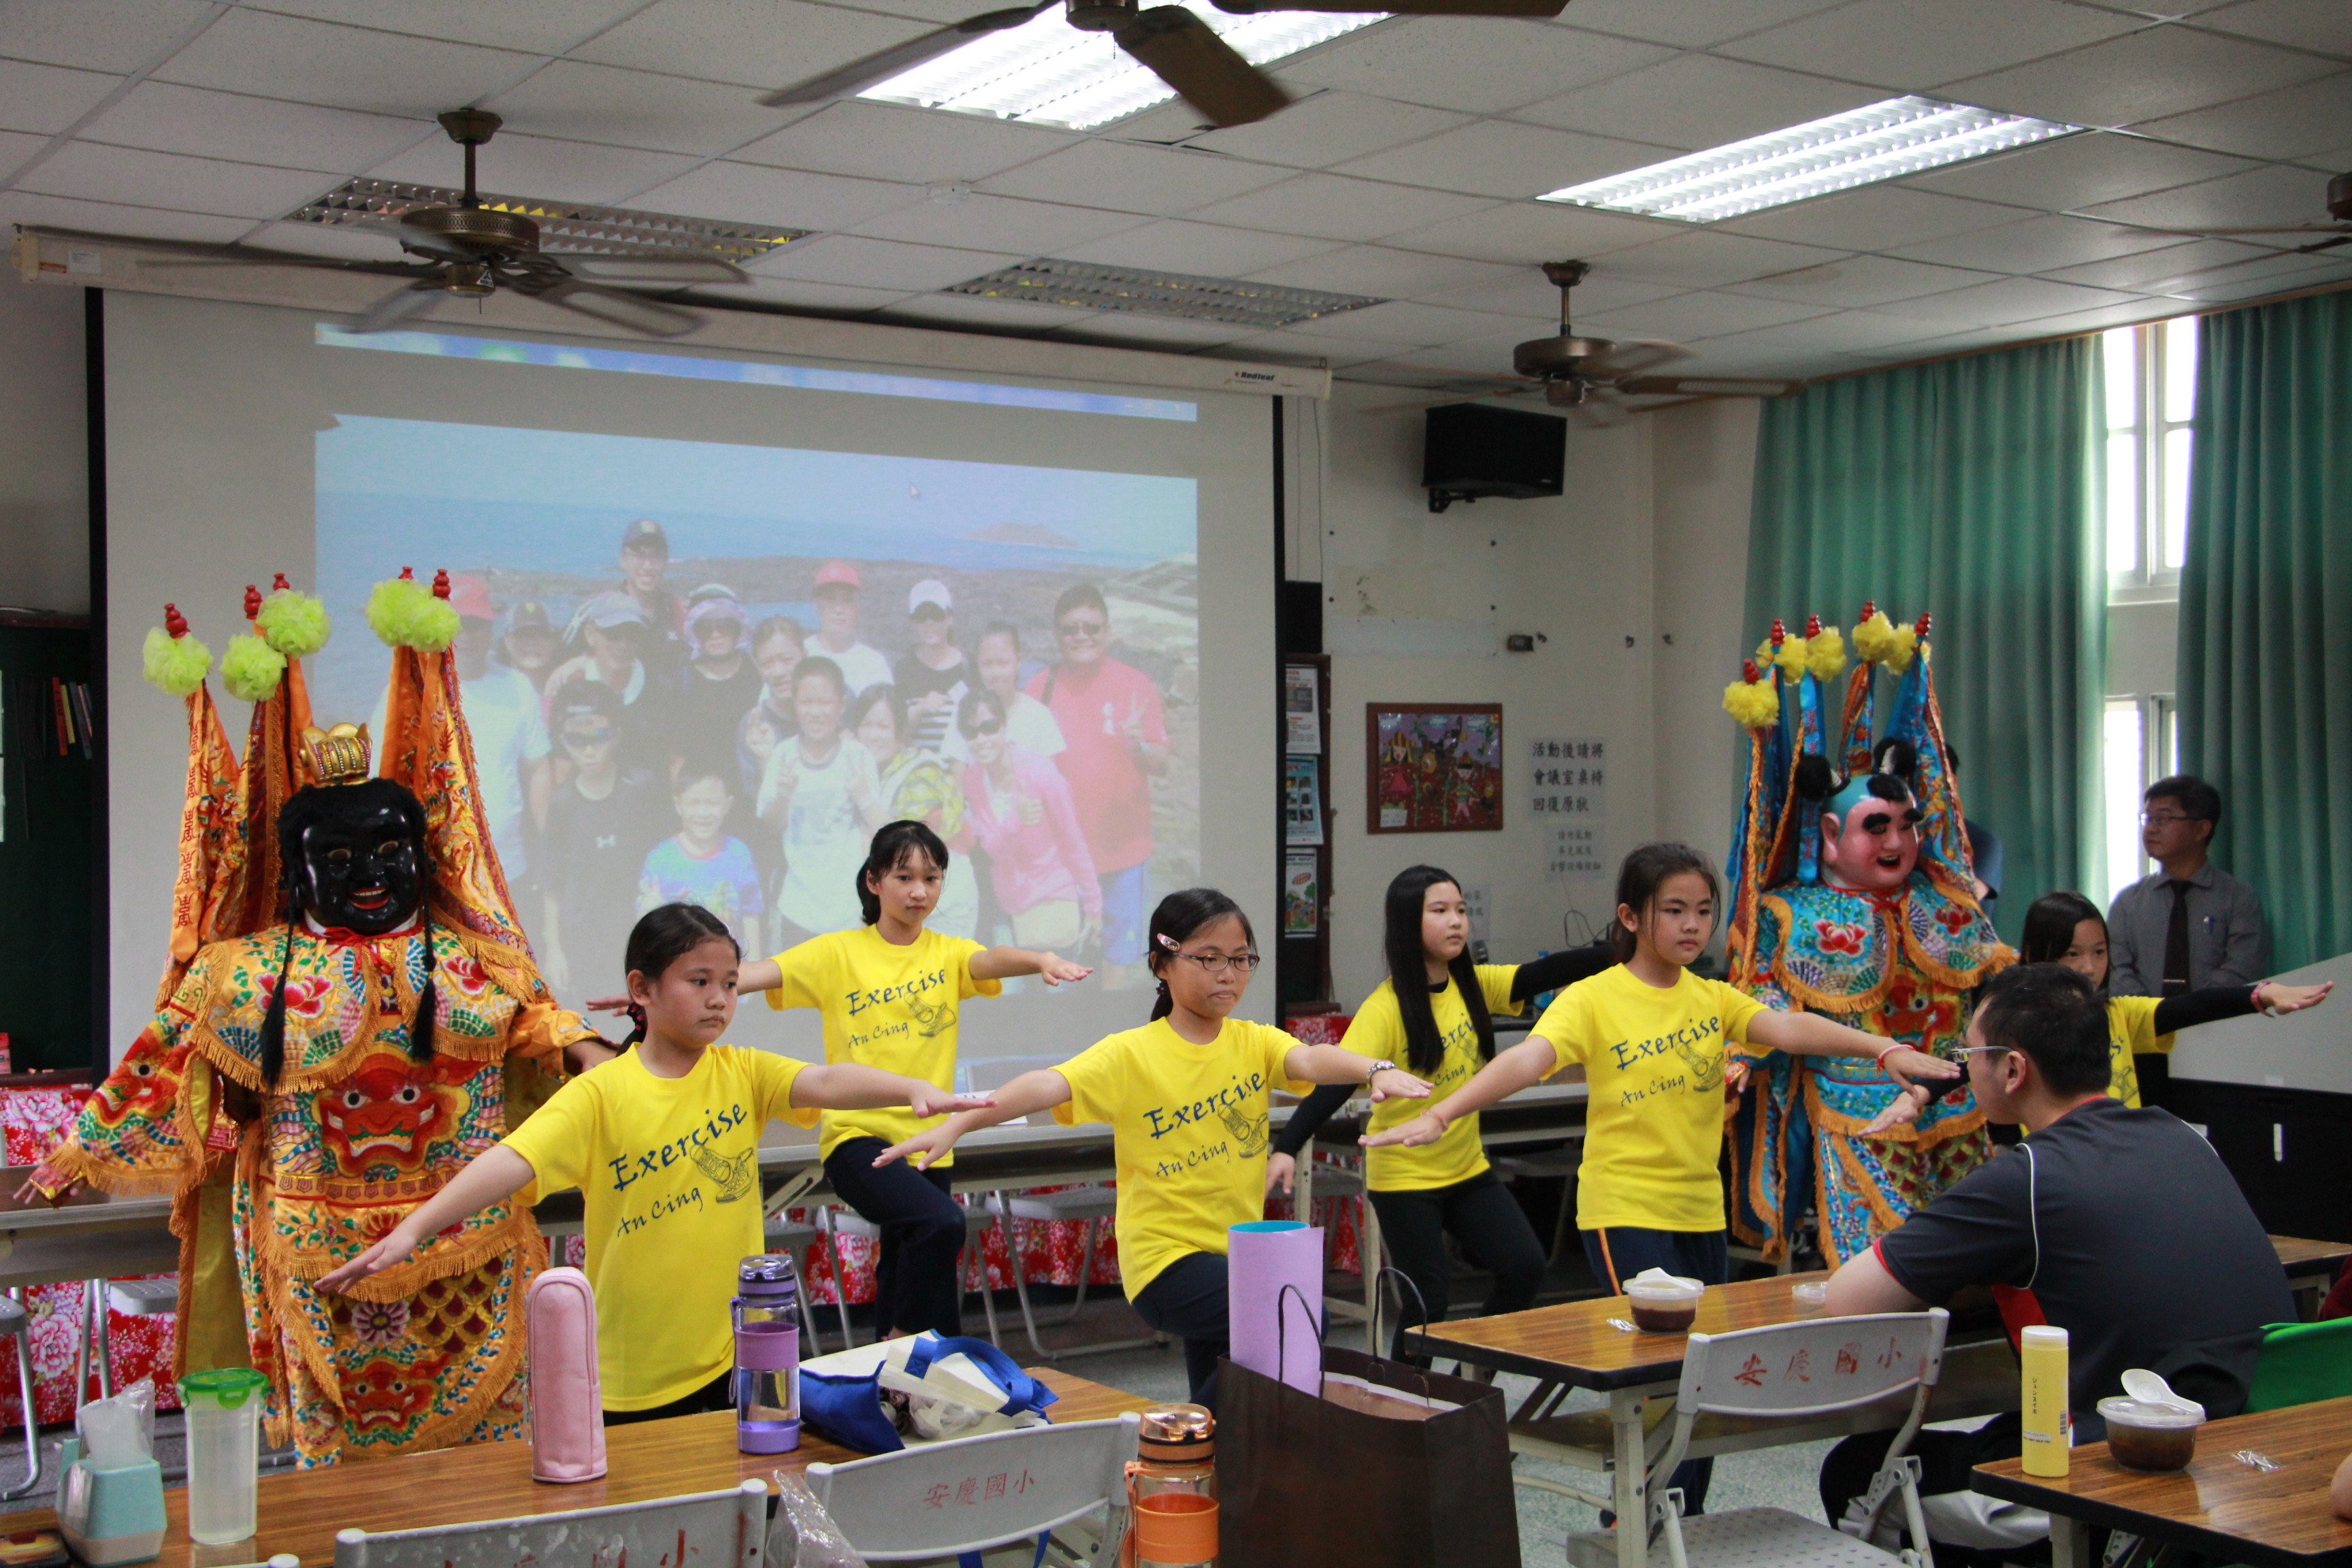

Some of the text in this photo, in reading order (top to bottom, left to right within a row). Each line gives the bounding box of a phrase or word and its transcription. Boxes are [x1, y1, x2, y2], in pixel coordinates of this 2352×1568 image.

[1533, 741, 1603, 759] 活動後請將
[1534, 768, 1603, 786] 會議室桌椅
[1533, 796, 1589, 813] 回復原狀
[845, 968, 945, 1017] Exercise
[848, 1022, 909, 1049] An Cing
[1610, 1016, 1720, 1071] Exercise
[1434, 1064, 1467, 1086] Cing
[1620, 1075, 1686, 1107] An Cing
[608, 1103, 747, 1192] Exercise
[1155, 1141, 1230, 1177] An Cing
[617, 1187, 704, 1238] An Cing
[921, 1469, 1035, 1509] 安慶國小
